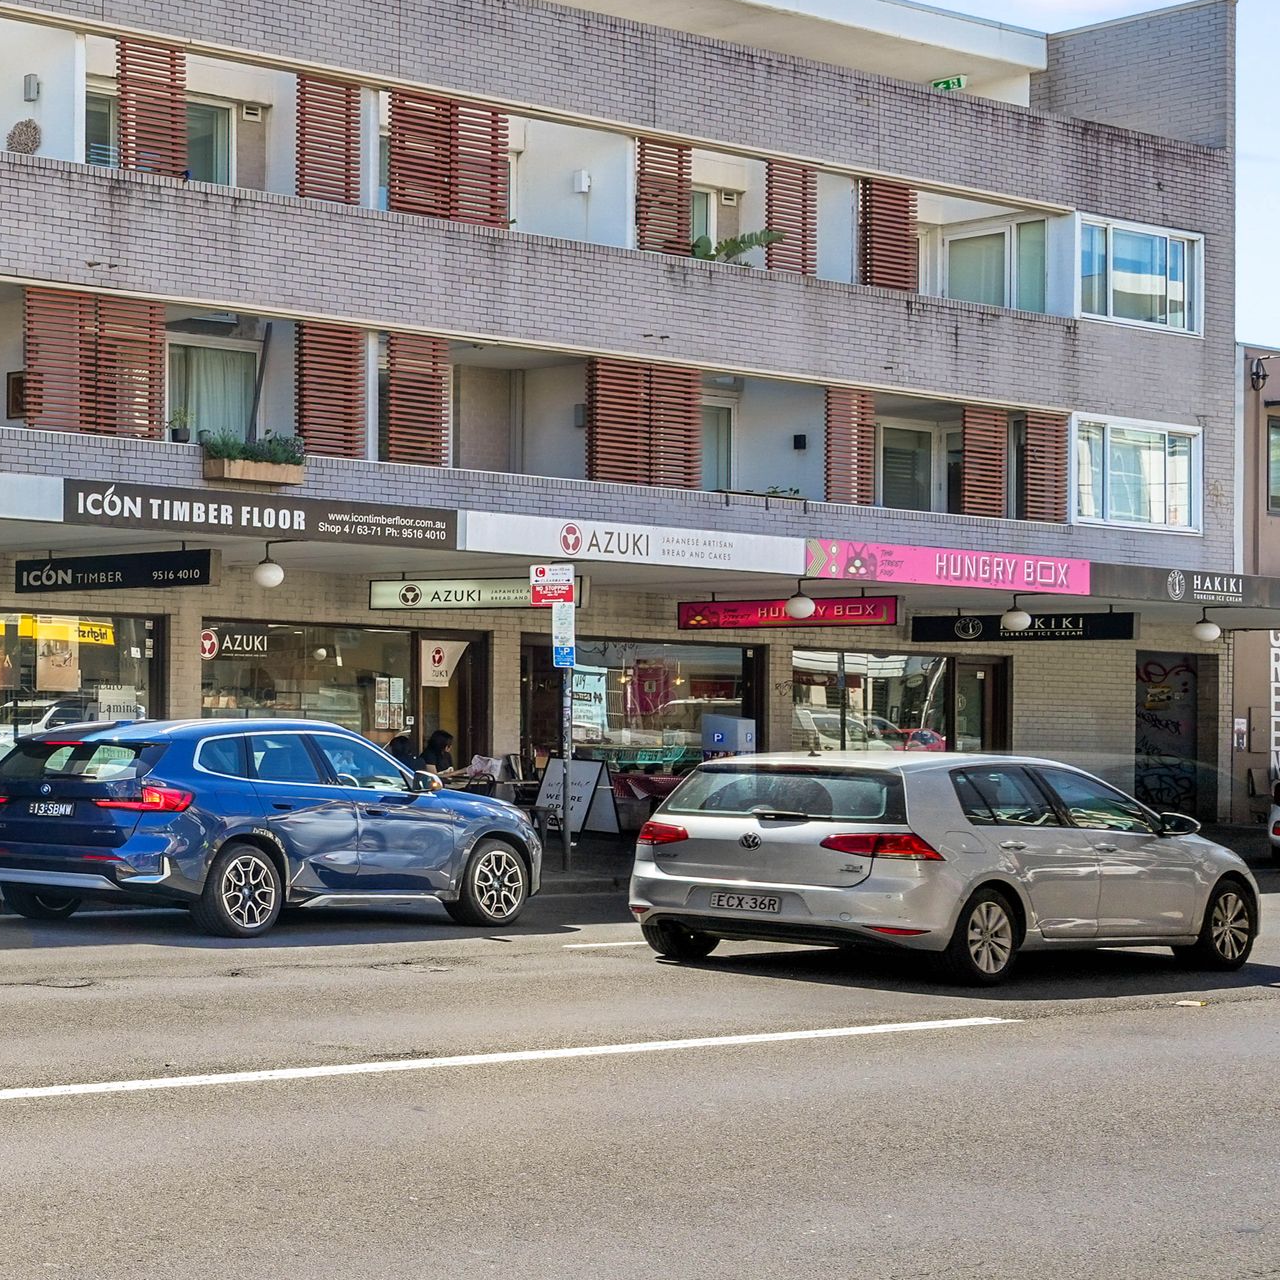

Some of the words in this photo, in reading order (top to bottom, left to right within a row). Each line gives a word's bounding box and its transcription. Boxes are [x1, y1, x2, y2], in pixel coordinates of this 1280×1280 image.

[149, 498, 233, 525] TIMBER
[241, 506, 306, 531] FLOOR
[328, 512, 446, 529] www.icontimberfloor.com.au
[318, 522, 341, 534] Shop
[343, 525, 349, 533] 4
[357, 525, 381, 536] 63-71
[385, 527, 400, 537] Ph:
[402, 529, 423, 539] 9516
[425, 530, 446, 540] 4010
[587, 530, 650, 557] AZUKI
[661, 537, 699, 547] JAPANESE
[702, 540, 734, 549] ARTISAN
[661, 549, 686, 558] BREAD
[689, 551, 706, 559] AND
[708, 552, 732, 561] CAKES
[152, 570, 174, 580] 9516
[176, 569, 200, 580] 4010
[935, 553, 1016, 581] HUNGRY
[76, 571, 123, 584] TIMBER
[430, 589, 482, 603] AZUKI
[757, 605, 827, 619] HUY
[222, 634, 267, 651] AZUKI
